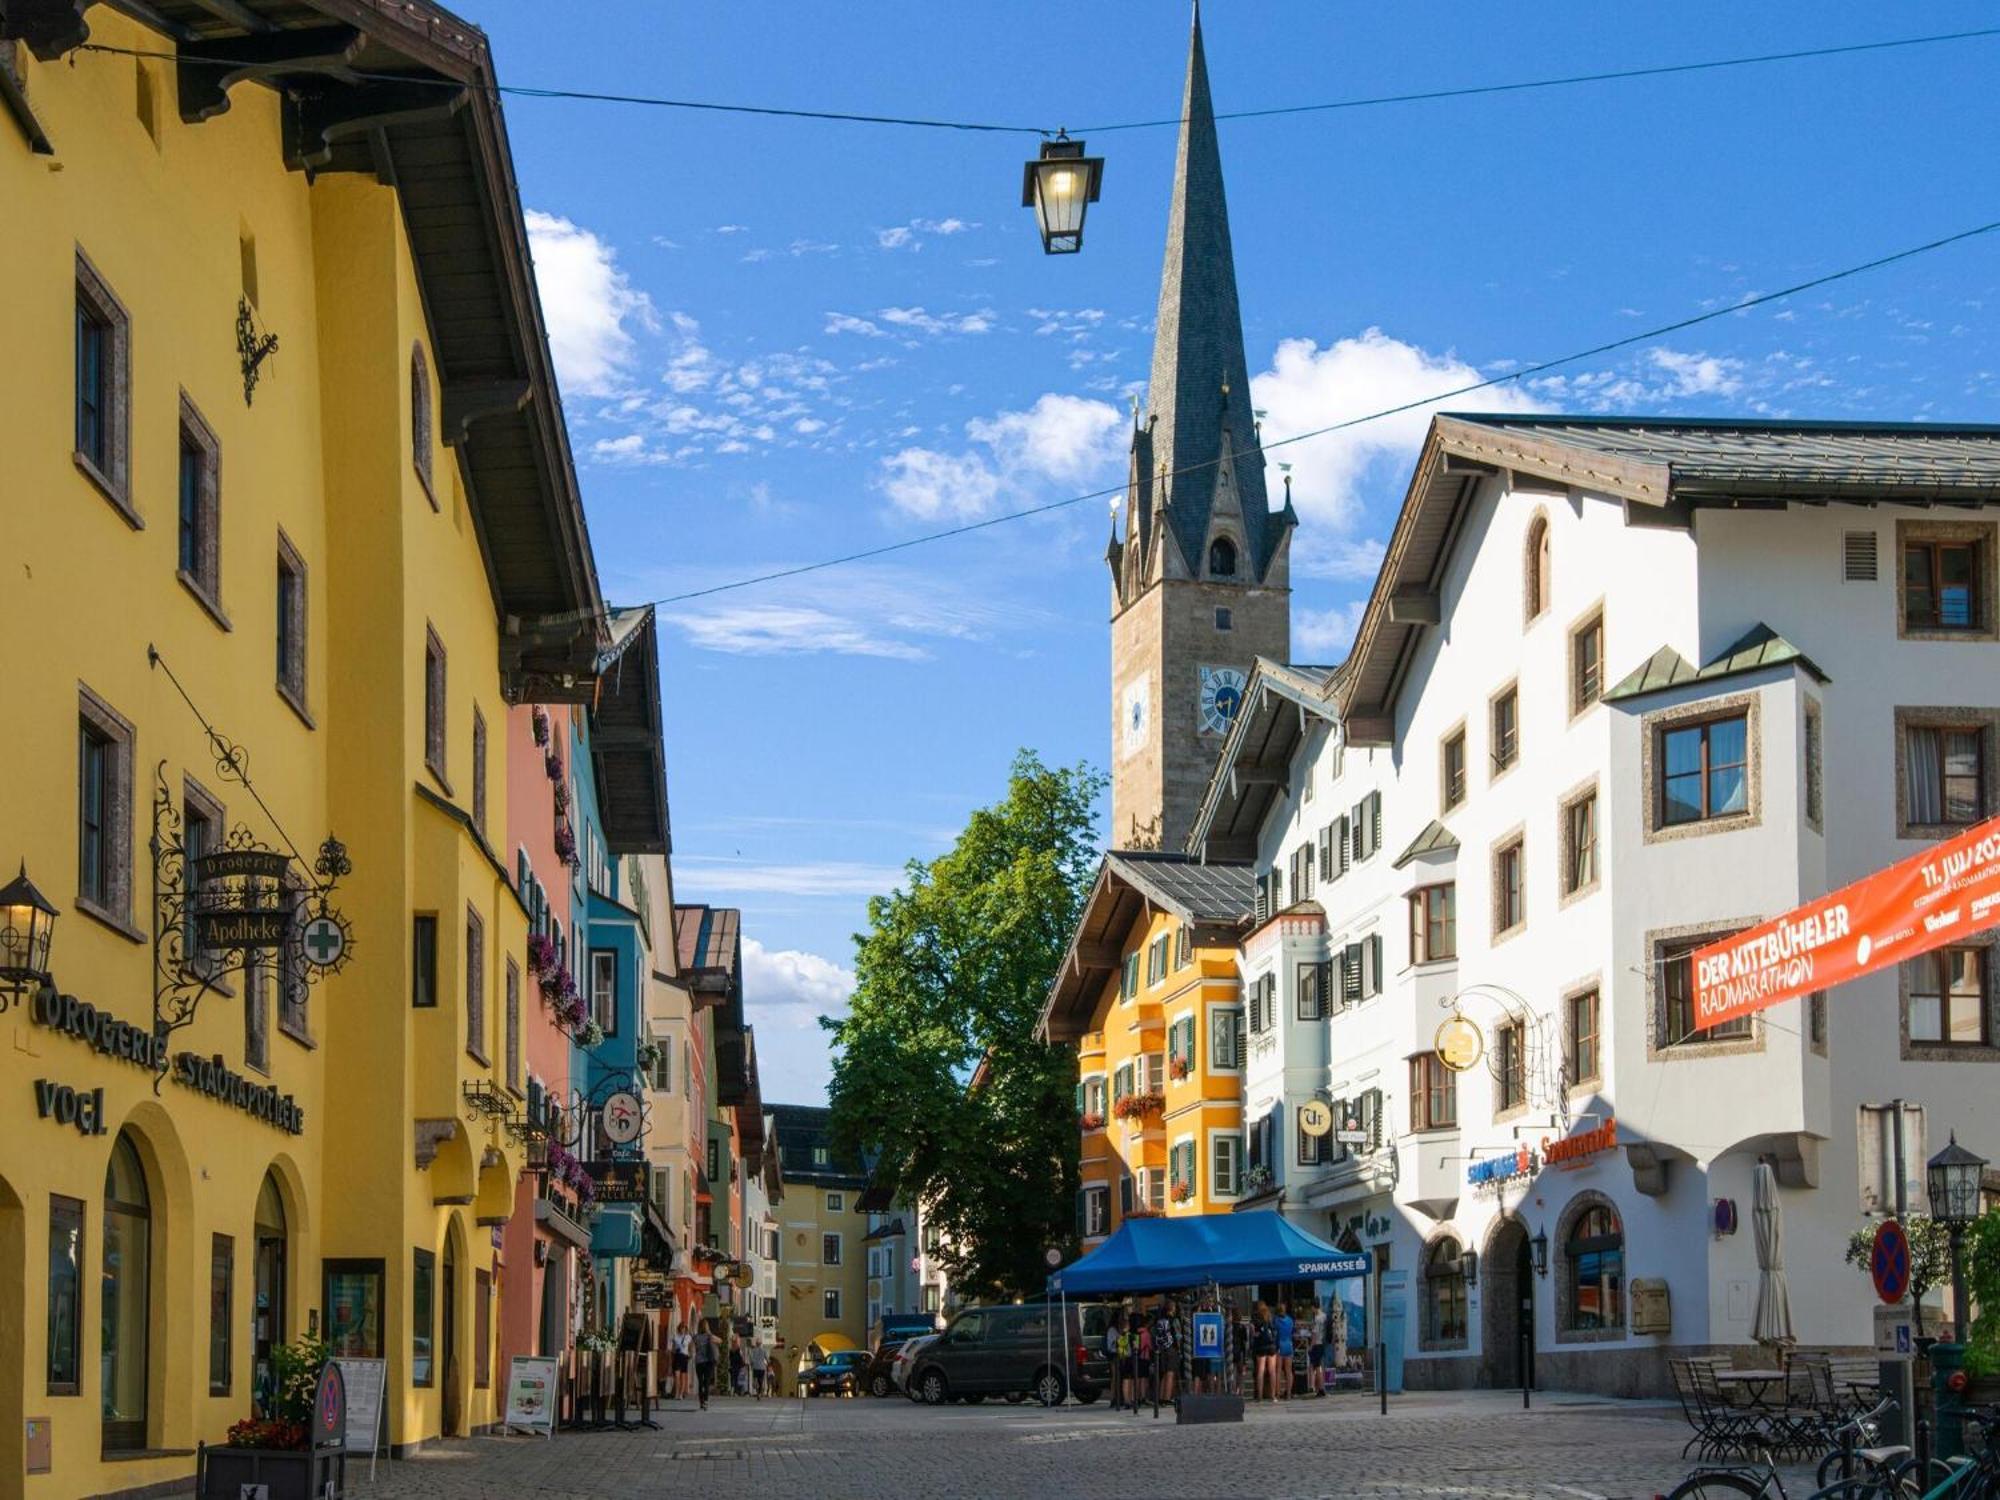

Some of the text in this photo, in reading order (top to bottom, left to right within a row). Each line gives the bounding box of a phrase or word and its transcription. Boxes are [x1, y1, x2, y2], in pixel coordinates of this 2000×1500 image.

[207, 855, 278, 874] Drogerie
[1921, 864, 1942, 888] 11.
[208, 916, 281, 942] Apotheke
[1698, 904, 1850, 989] DER KITZBÜHELER
[1701, 953, 1814, 1017] RADMARATHON
[32, 987, 168, 1073] DROGERIE
[33, 1078, 108, 1136] VOGL
[1298, 1260, 1356, 1274] SPARKASSE
